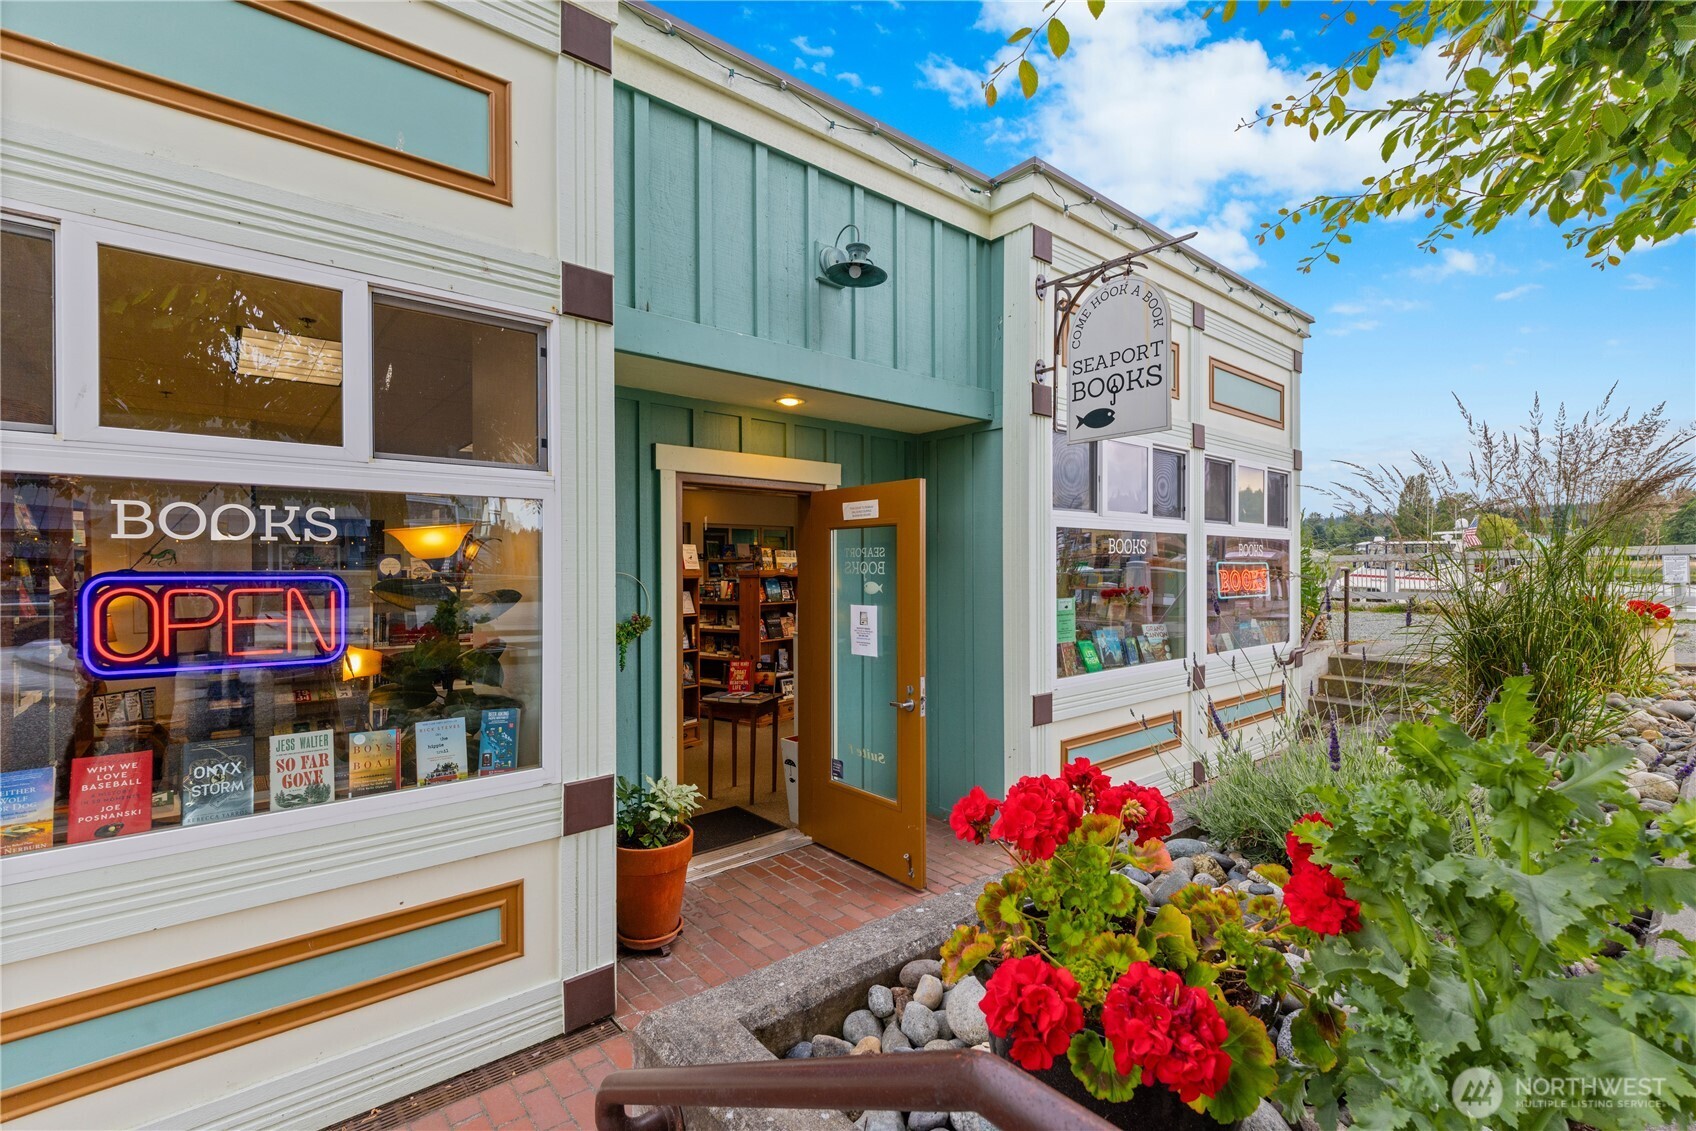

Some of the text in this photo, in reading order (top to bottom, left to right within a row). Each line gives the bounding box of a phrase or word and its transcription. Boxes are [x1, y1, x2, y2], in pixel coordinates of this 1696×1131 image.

[1071, 283, 1164, 350] COME HOOK A BOOK
[1072, 340, 1164, 376] SEAPORT
[1071, 364, 1163, 405] BOOKS
[110, 499, 338, 542] BOOKS
[1108, 538, 1147, 555] BOOKS
[1238, 543, 1264, 557] BOOKS
[1218, 568, 1268, 593] BOOKS
[93, 587, 337, 663] OPEN
[276, 734, 329, 752] JESS WALTER
[353, 742, 392, 755] BOYS
[87, 762, 138, 774] WHY WE
[193, 761, 242, 779] ONYX
[276, 753, 330, 773] SO FAR
[353, 757, 393, 771] BOAT
[97, 772, 128, 781] LOVE
[282, 769, 324, 789] GONE
[0, 787, 36, 796] EITHER
[81, 778, 142, 792] BASEBALL
[191, 779, 245, 798] STORM
[0, 796, 28, 805] WOLF
[78, 809, 142, 823] POSNANSKI
[101, 804, 121, 813] JOE
[187, 814, 219, 824] REBECCA
[4, 843, 47, 854] NERBURN
